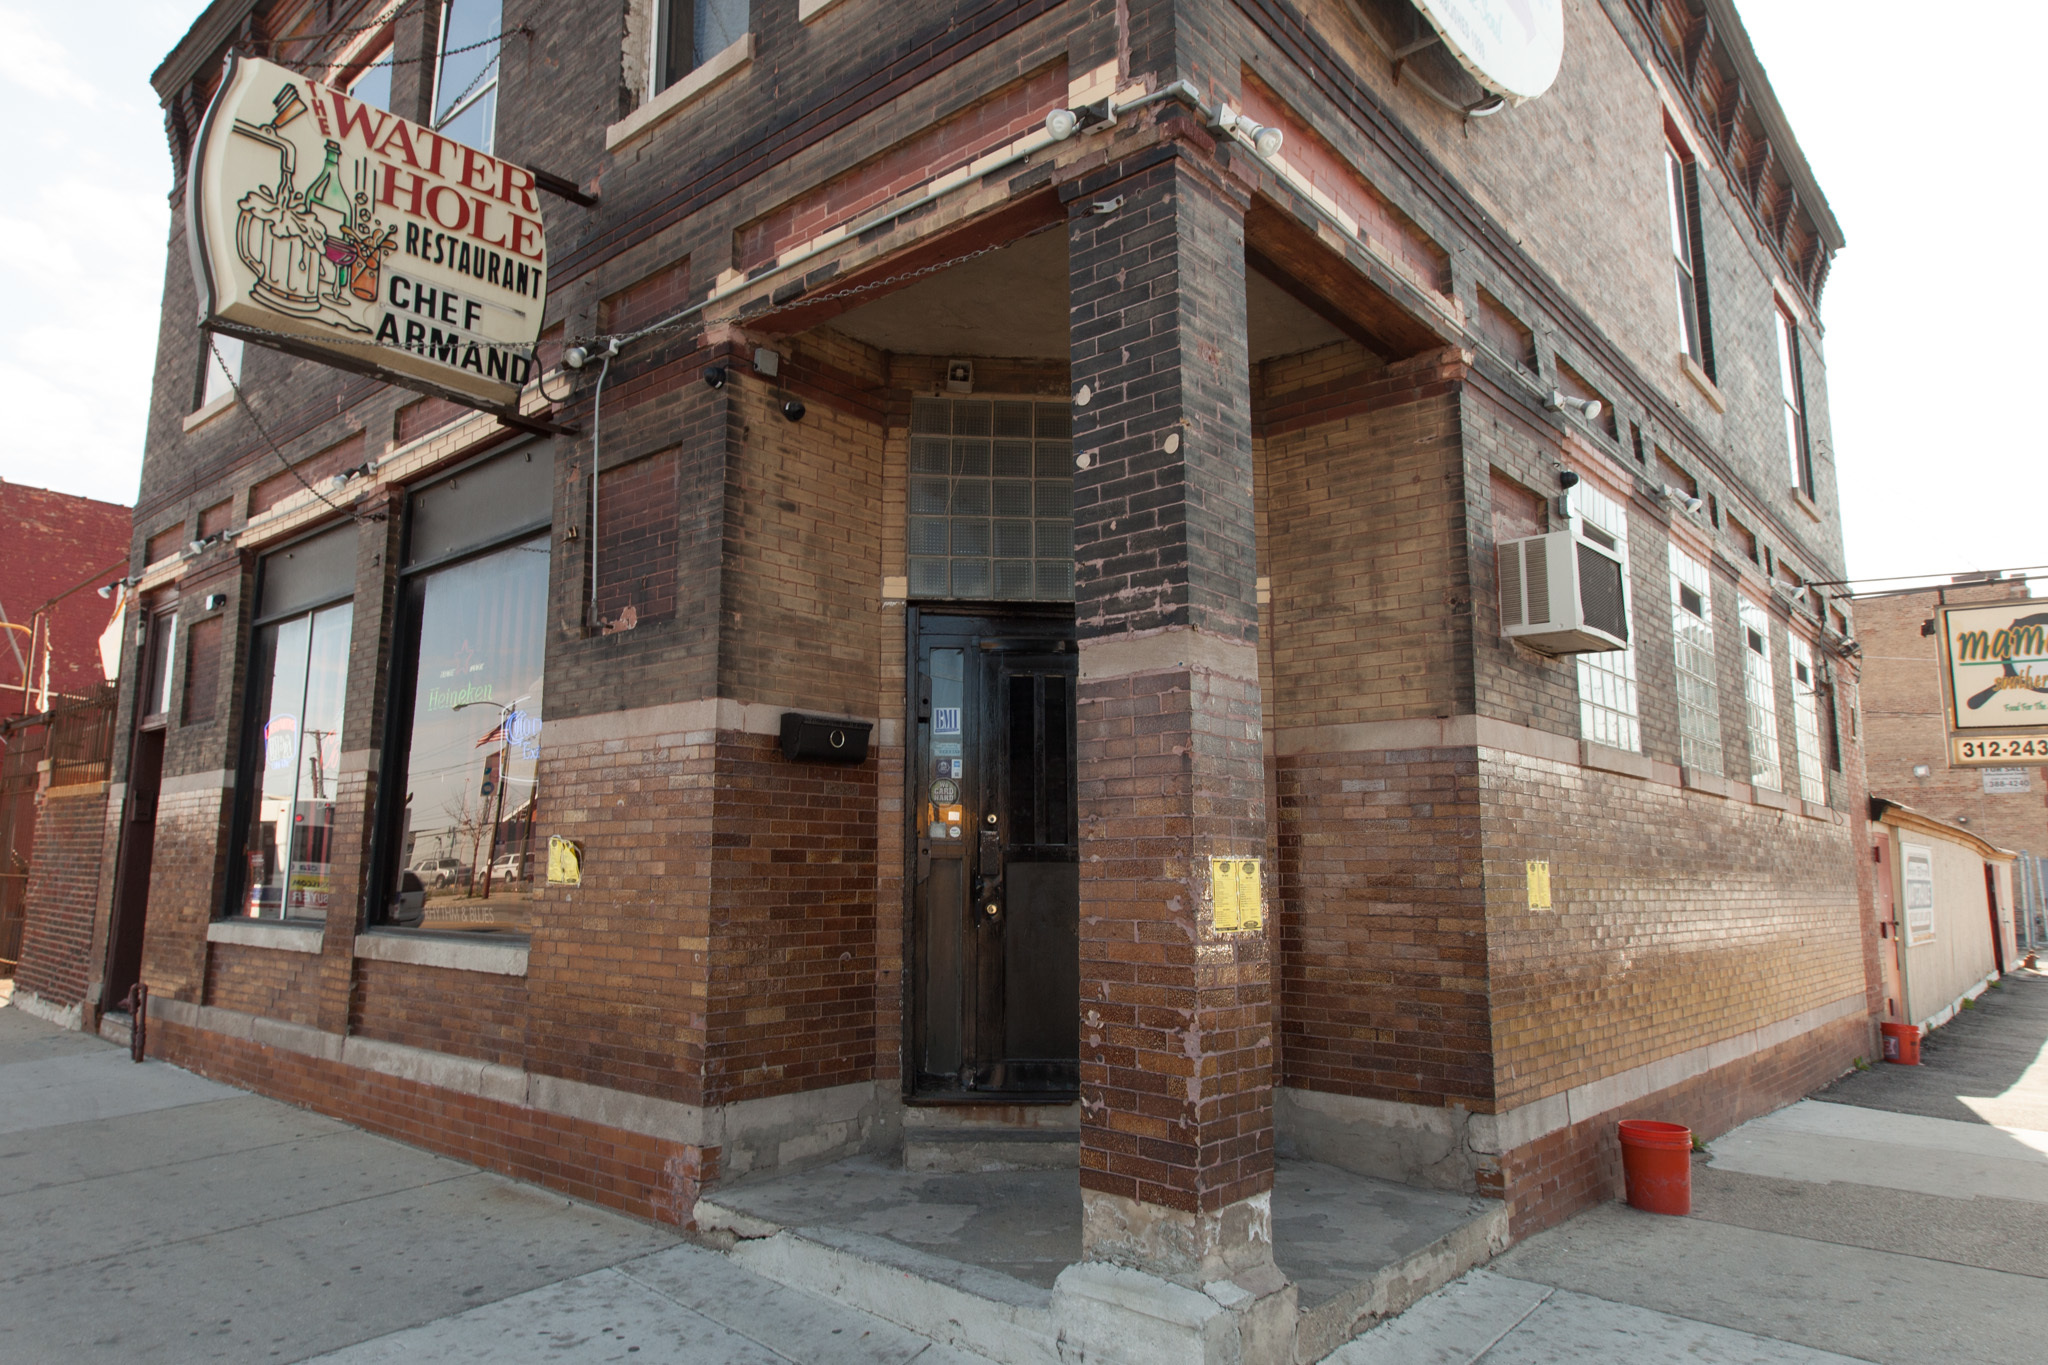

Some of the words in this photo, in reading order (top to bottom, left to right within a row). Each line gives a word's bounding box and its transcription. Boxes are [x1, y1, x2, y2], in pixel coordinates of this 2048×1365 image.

[305, 79, 332, 136] THE
[326, 89, 539, 213] WATER
[375, 160, 544, 262] HOLE
[405, 221, 543, 300] RESTAURANT
[389, 274, 482, 330] CHEF
[375, 312, 531, 385] ARMAND
[1957, 624, 2048, 661] mam
[428, 680, 492, 711] Heineken
[936, 709, 958, 729] BMI
[469, 907, 495, 924] BLUES
